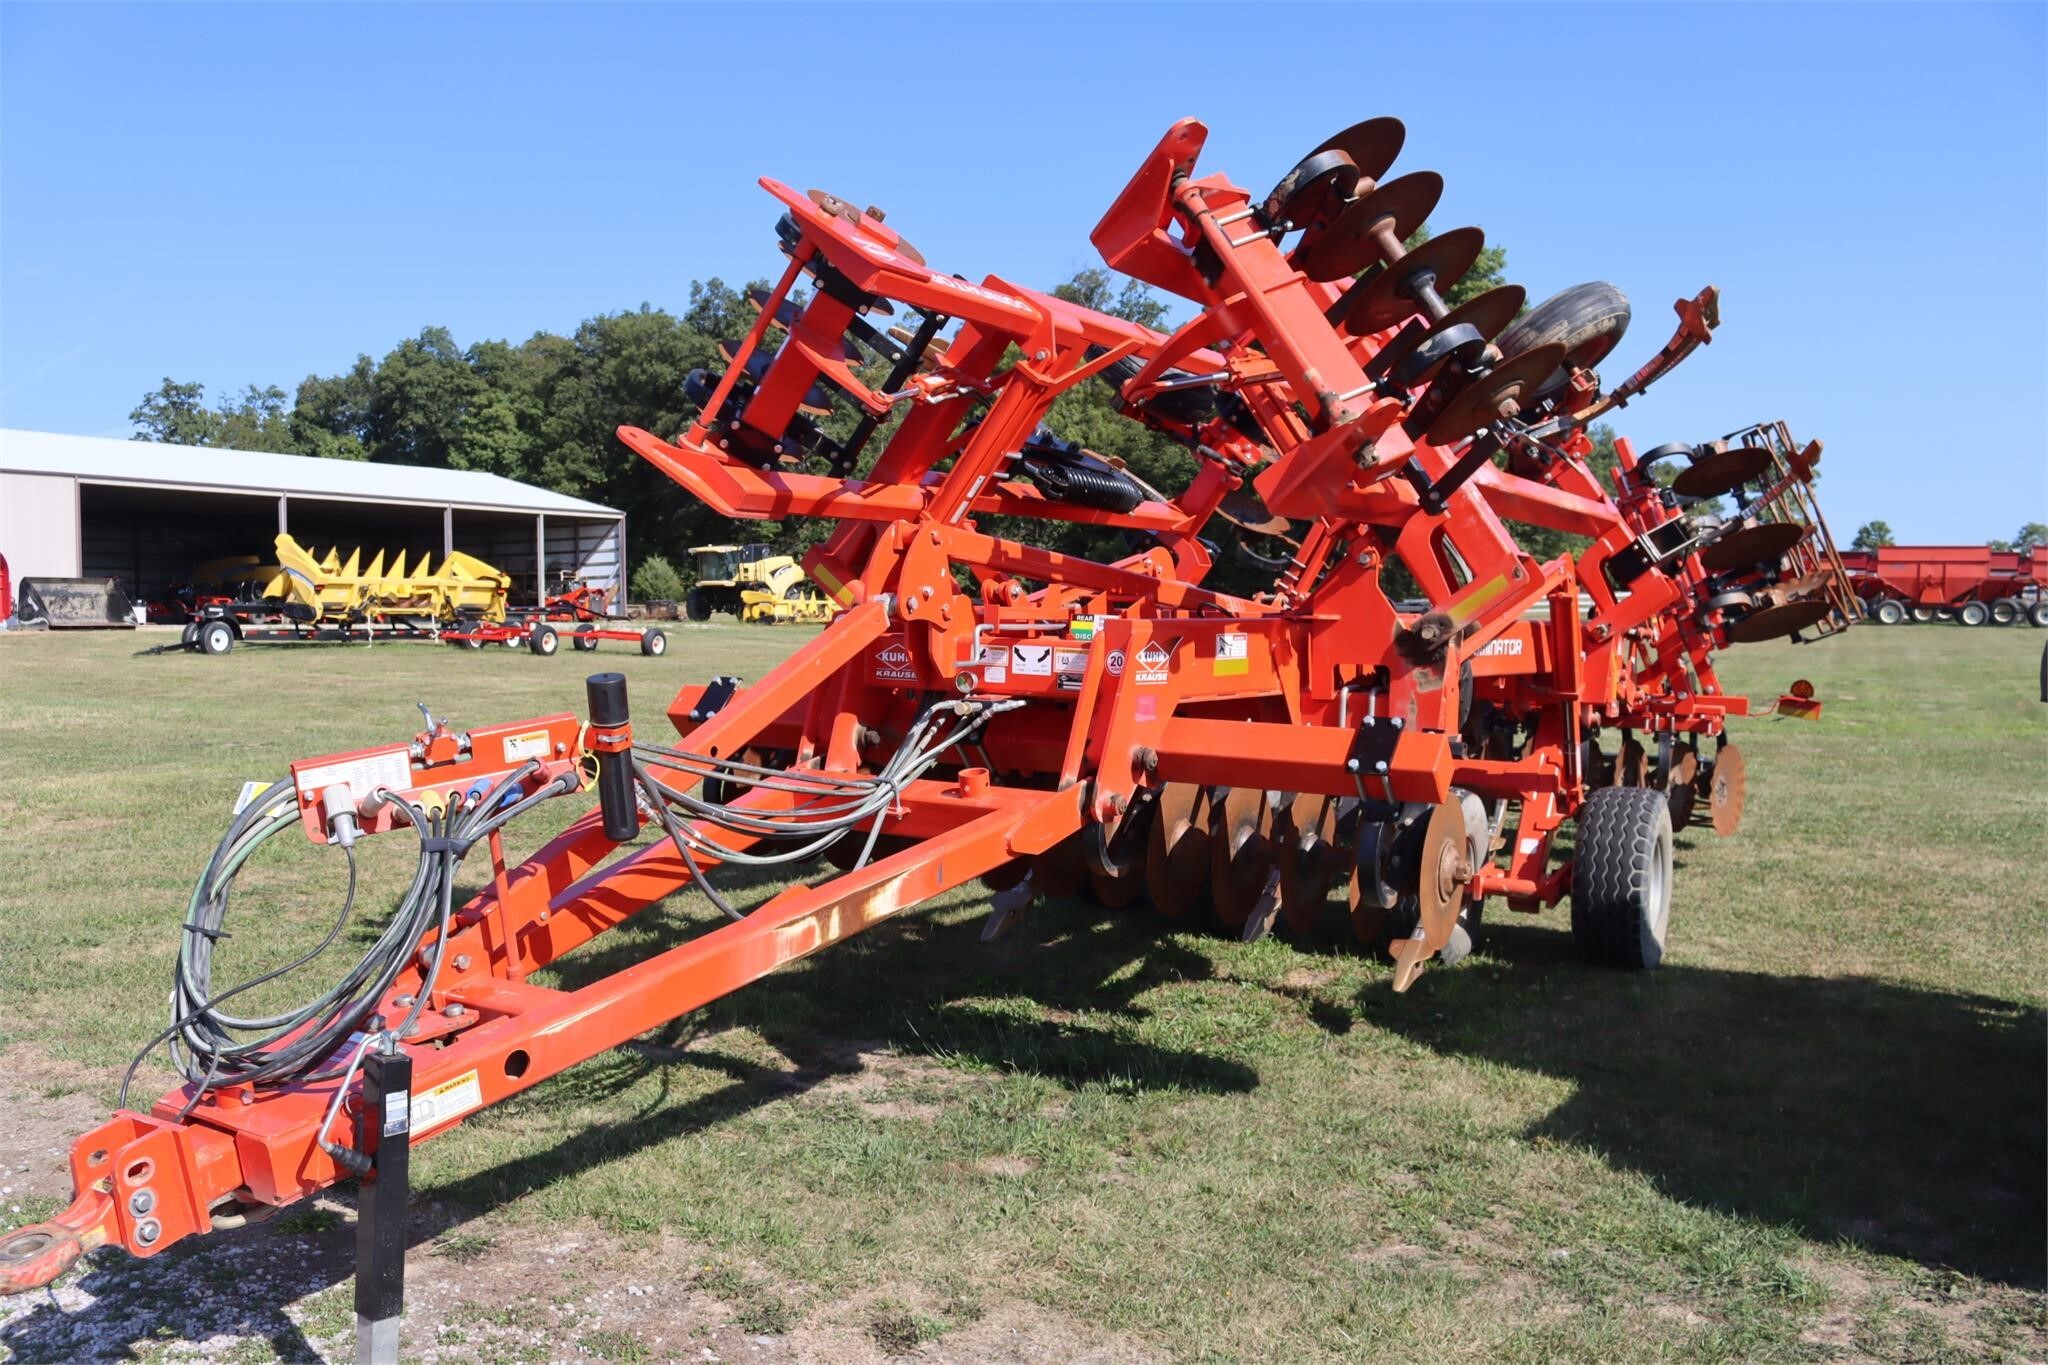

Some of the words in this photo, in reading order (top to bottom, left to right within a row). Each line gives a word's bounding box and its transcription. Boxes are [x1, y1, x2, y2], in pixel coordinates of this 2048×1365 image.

[1473, 639, 1523, 656] INATOR
[1110, 655, 1123, 667] 20
[1142, 651, 1165, 663] KUHN
[875, 670, 917, 679] KRAUSE
[1136, 673, 1168, 682] KRAUSE
